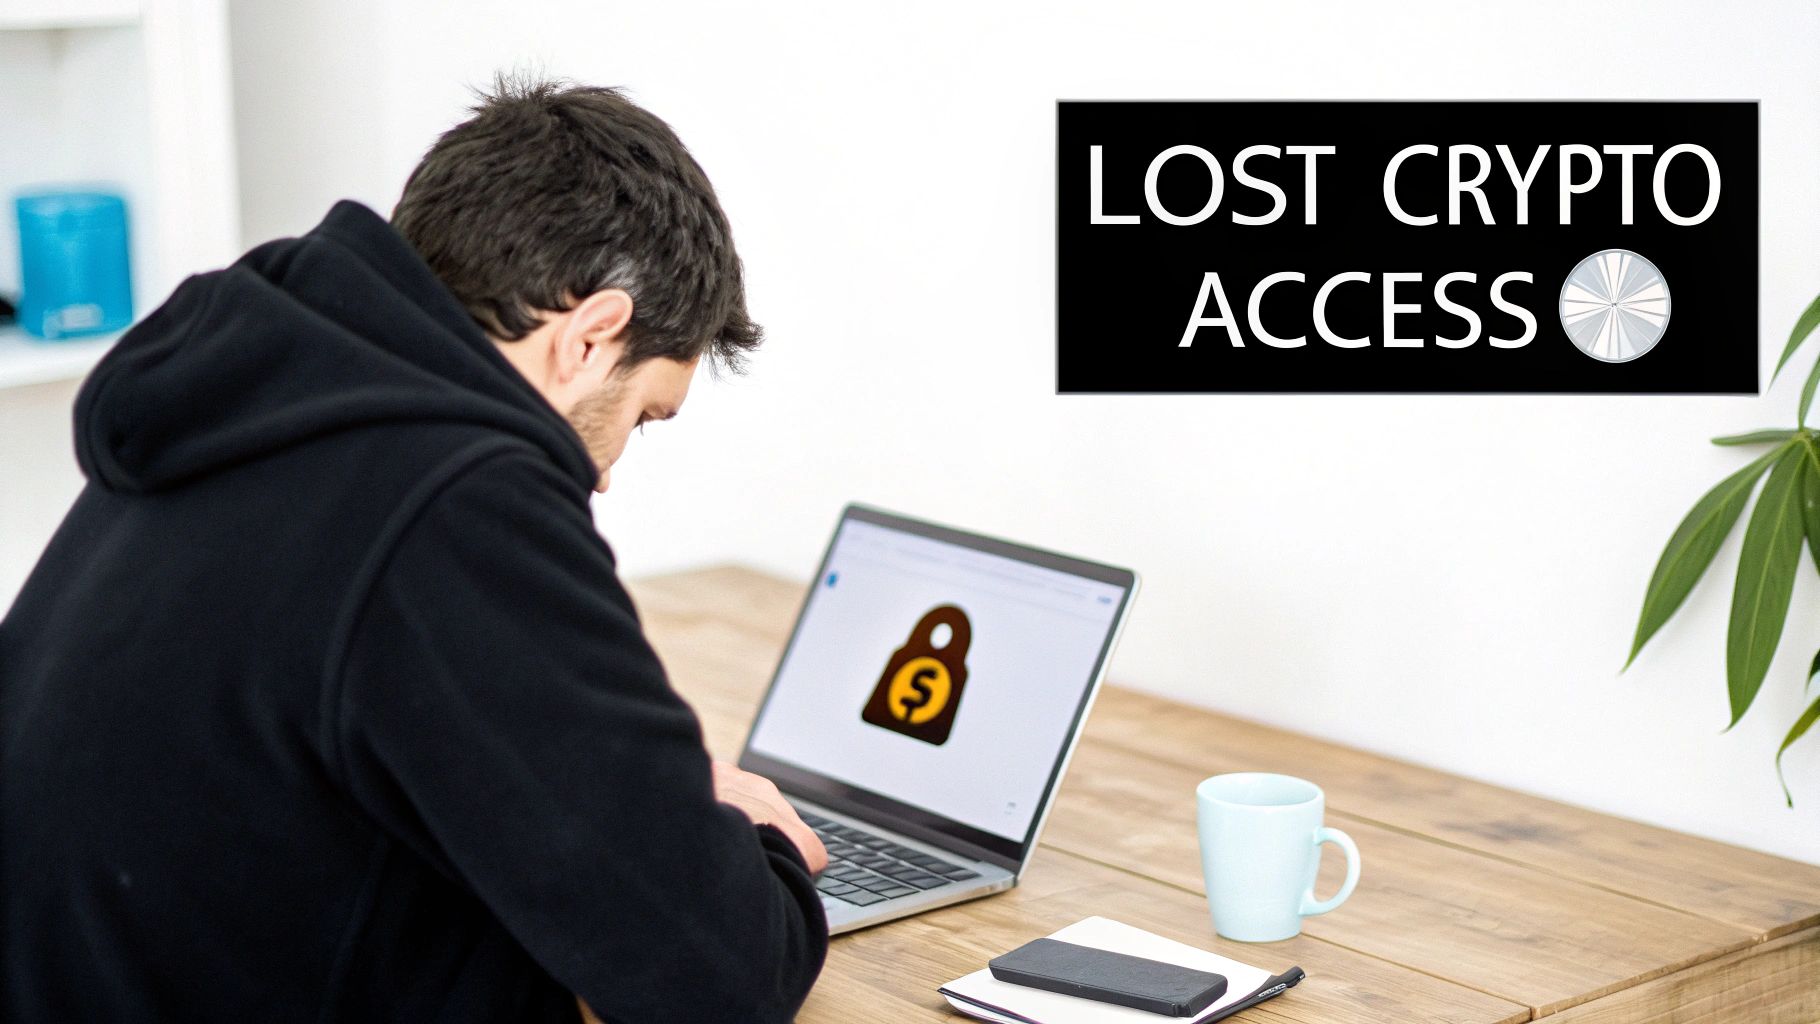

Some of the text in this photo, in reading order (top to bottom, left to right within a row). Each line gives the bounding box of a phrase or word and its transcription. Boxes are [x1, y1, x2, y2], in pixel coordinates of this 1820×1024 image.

[1090, 143, 1722, 227] LOST CRYPTO
[1178, 271, 1538, 349] ACCESS
